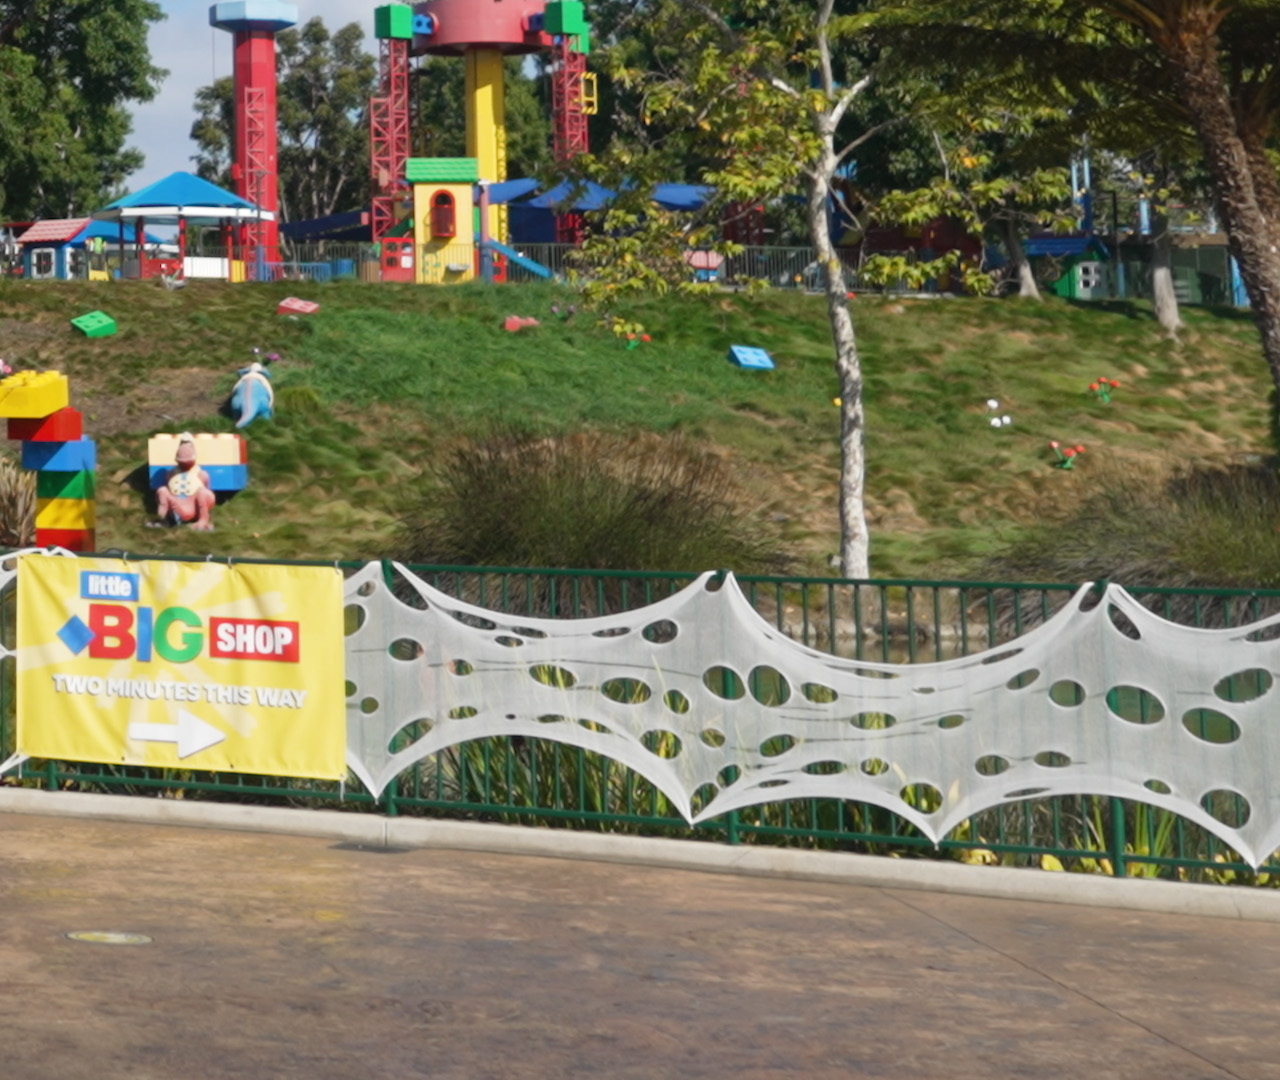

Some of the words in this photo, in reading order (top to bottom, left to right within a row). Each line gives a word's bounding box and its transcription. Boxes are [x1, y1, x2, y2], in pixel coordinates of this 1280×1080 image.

[88, 574, 132, 597] little
[88, 604, 204, 663] BIG
[216, 622, 293, 655] SHOP
[52, 673, 103, 695] TWO
[106, 677, 199, 702] MINUTES
[203, 683, 252, 706] THIS
[255, 687, 307, 709] WAY
